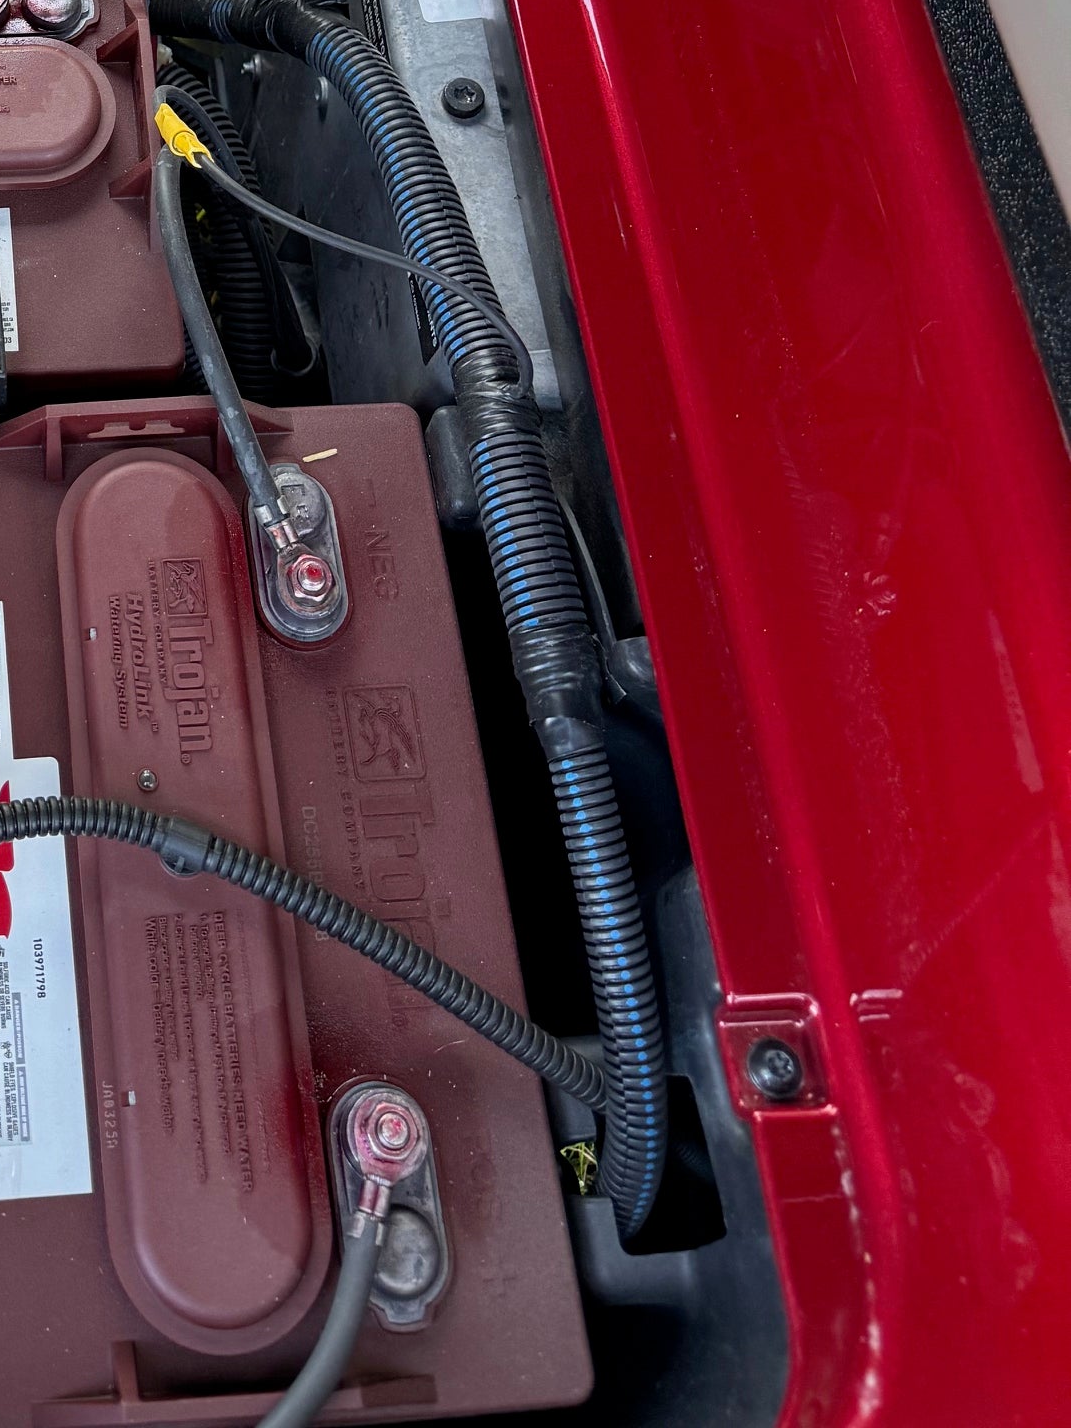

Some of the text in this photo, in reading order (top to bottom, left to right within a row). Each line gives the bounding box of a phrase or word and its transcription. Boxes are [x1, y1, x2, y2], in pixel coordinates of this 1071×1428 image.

[148, 560, 167, 683] BATTERY COMPANY
[365, 530, 399, 601] NEG
[109, 596, 129, 727] Watering System
[124, 594, 153, 719] HydroLink
[164, 619, 219, 751] Trojan
[339, 792, 365, 891] COMPANY
[33, 938, 46, 998] 103971798
[213, 912, 253, 1192] DEEP CYCLE BATTERIES NEED WATER
